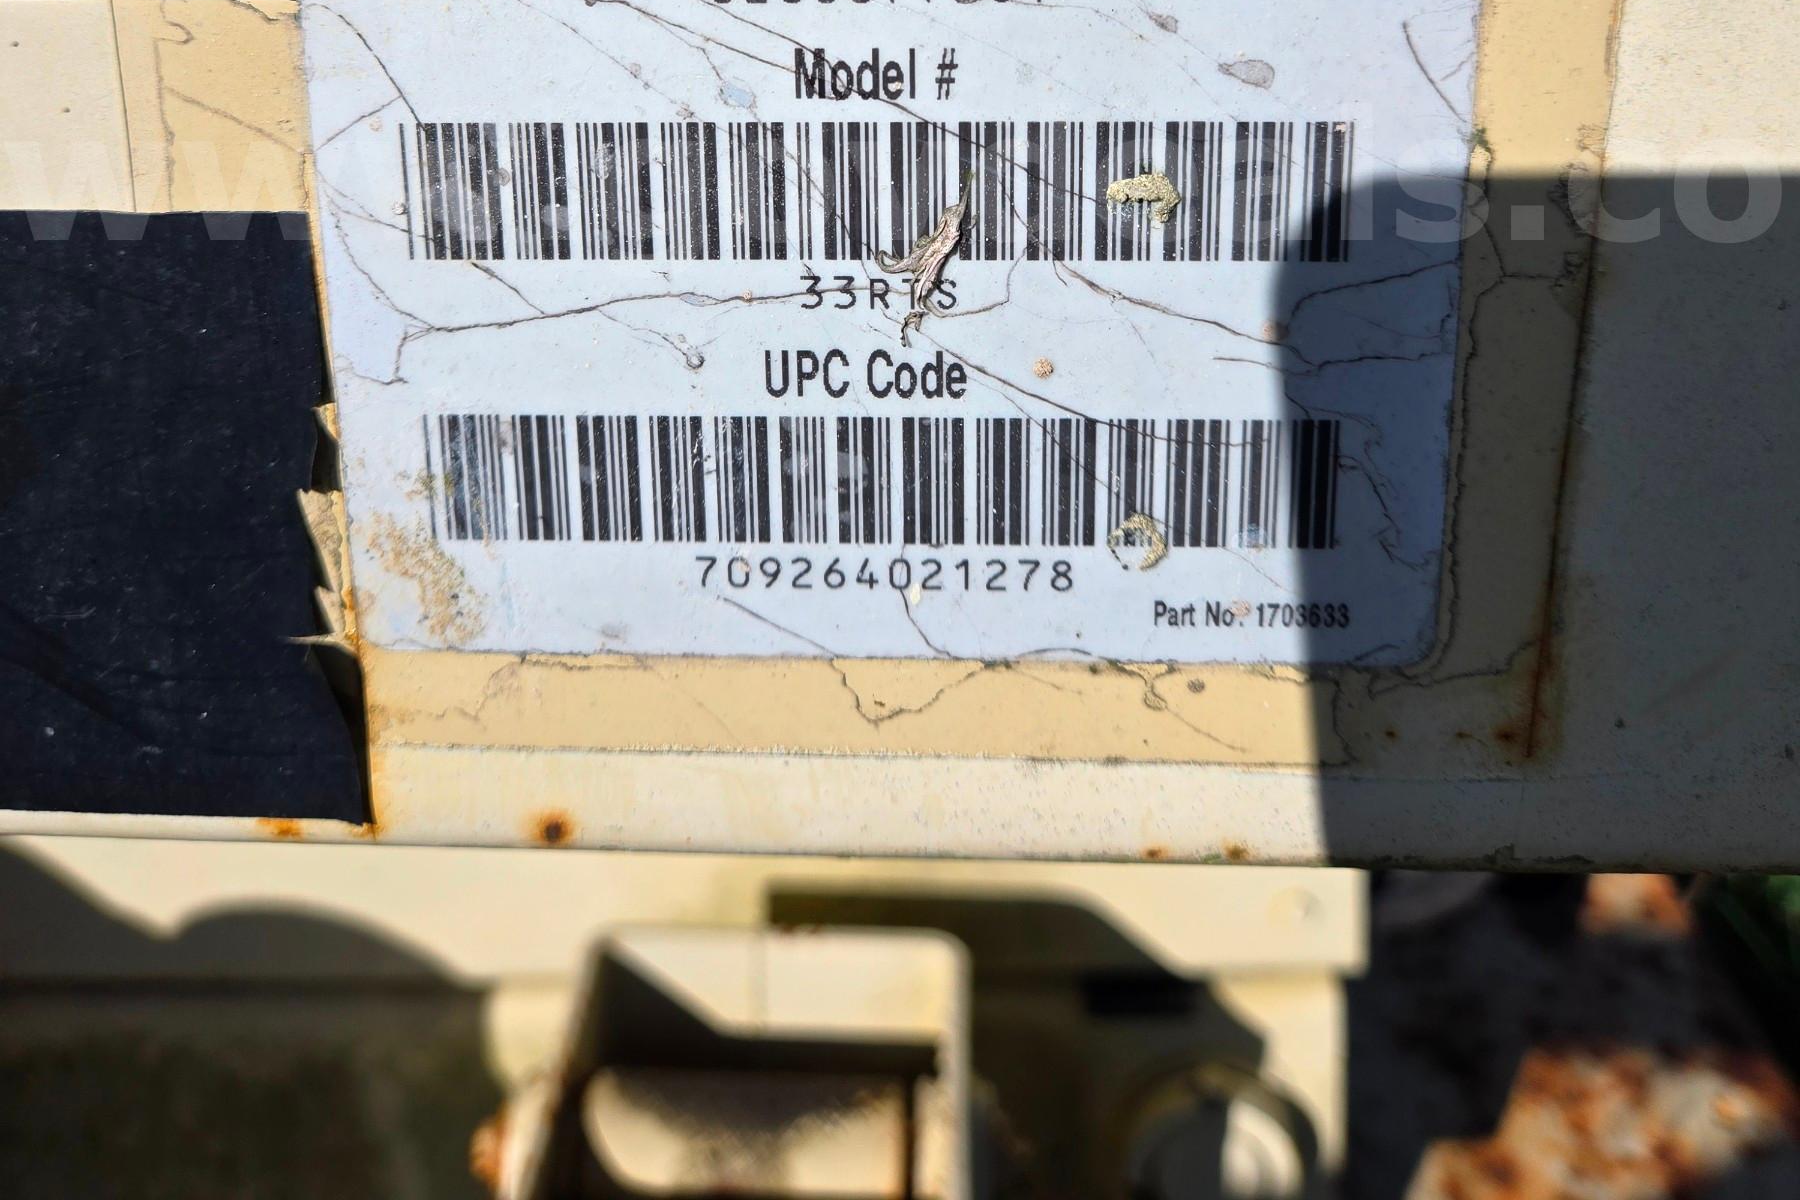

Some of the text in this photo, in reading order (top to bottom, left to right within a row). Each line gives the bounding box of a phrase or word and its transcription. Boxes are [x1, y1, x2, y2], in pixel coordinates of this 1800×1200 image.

[794, 47, 959, 100] Model #
[764, 349, 968, 400] UPC Code
[695, 555, 1074, 592] 709264021278
[1153, 600, 1350, 628] Part No. 1703633
